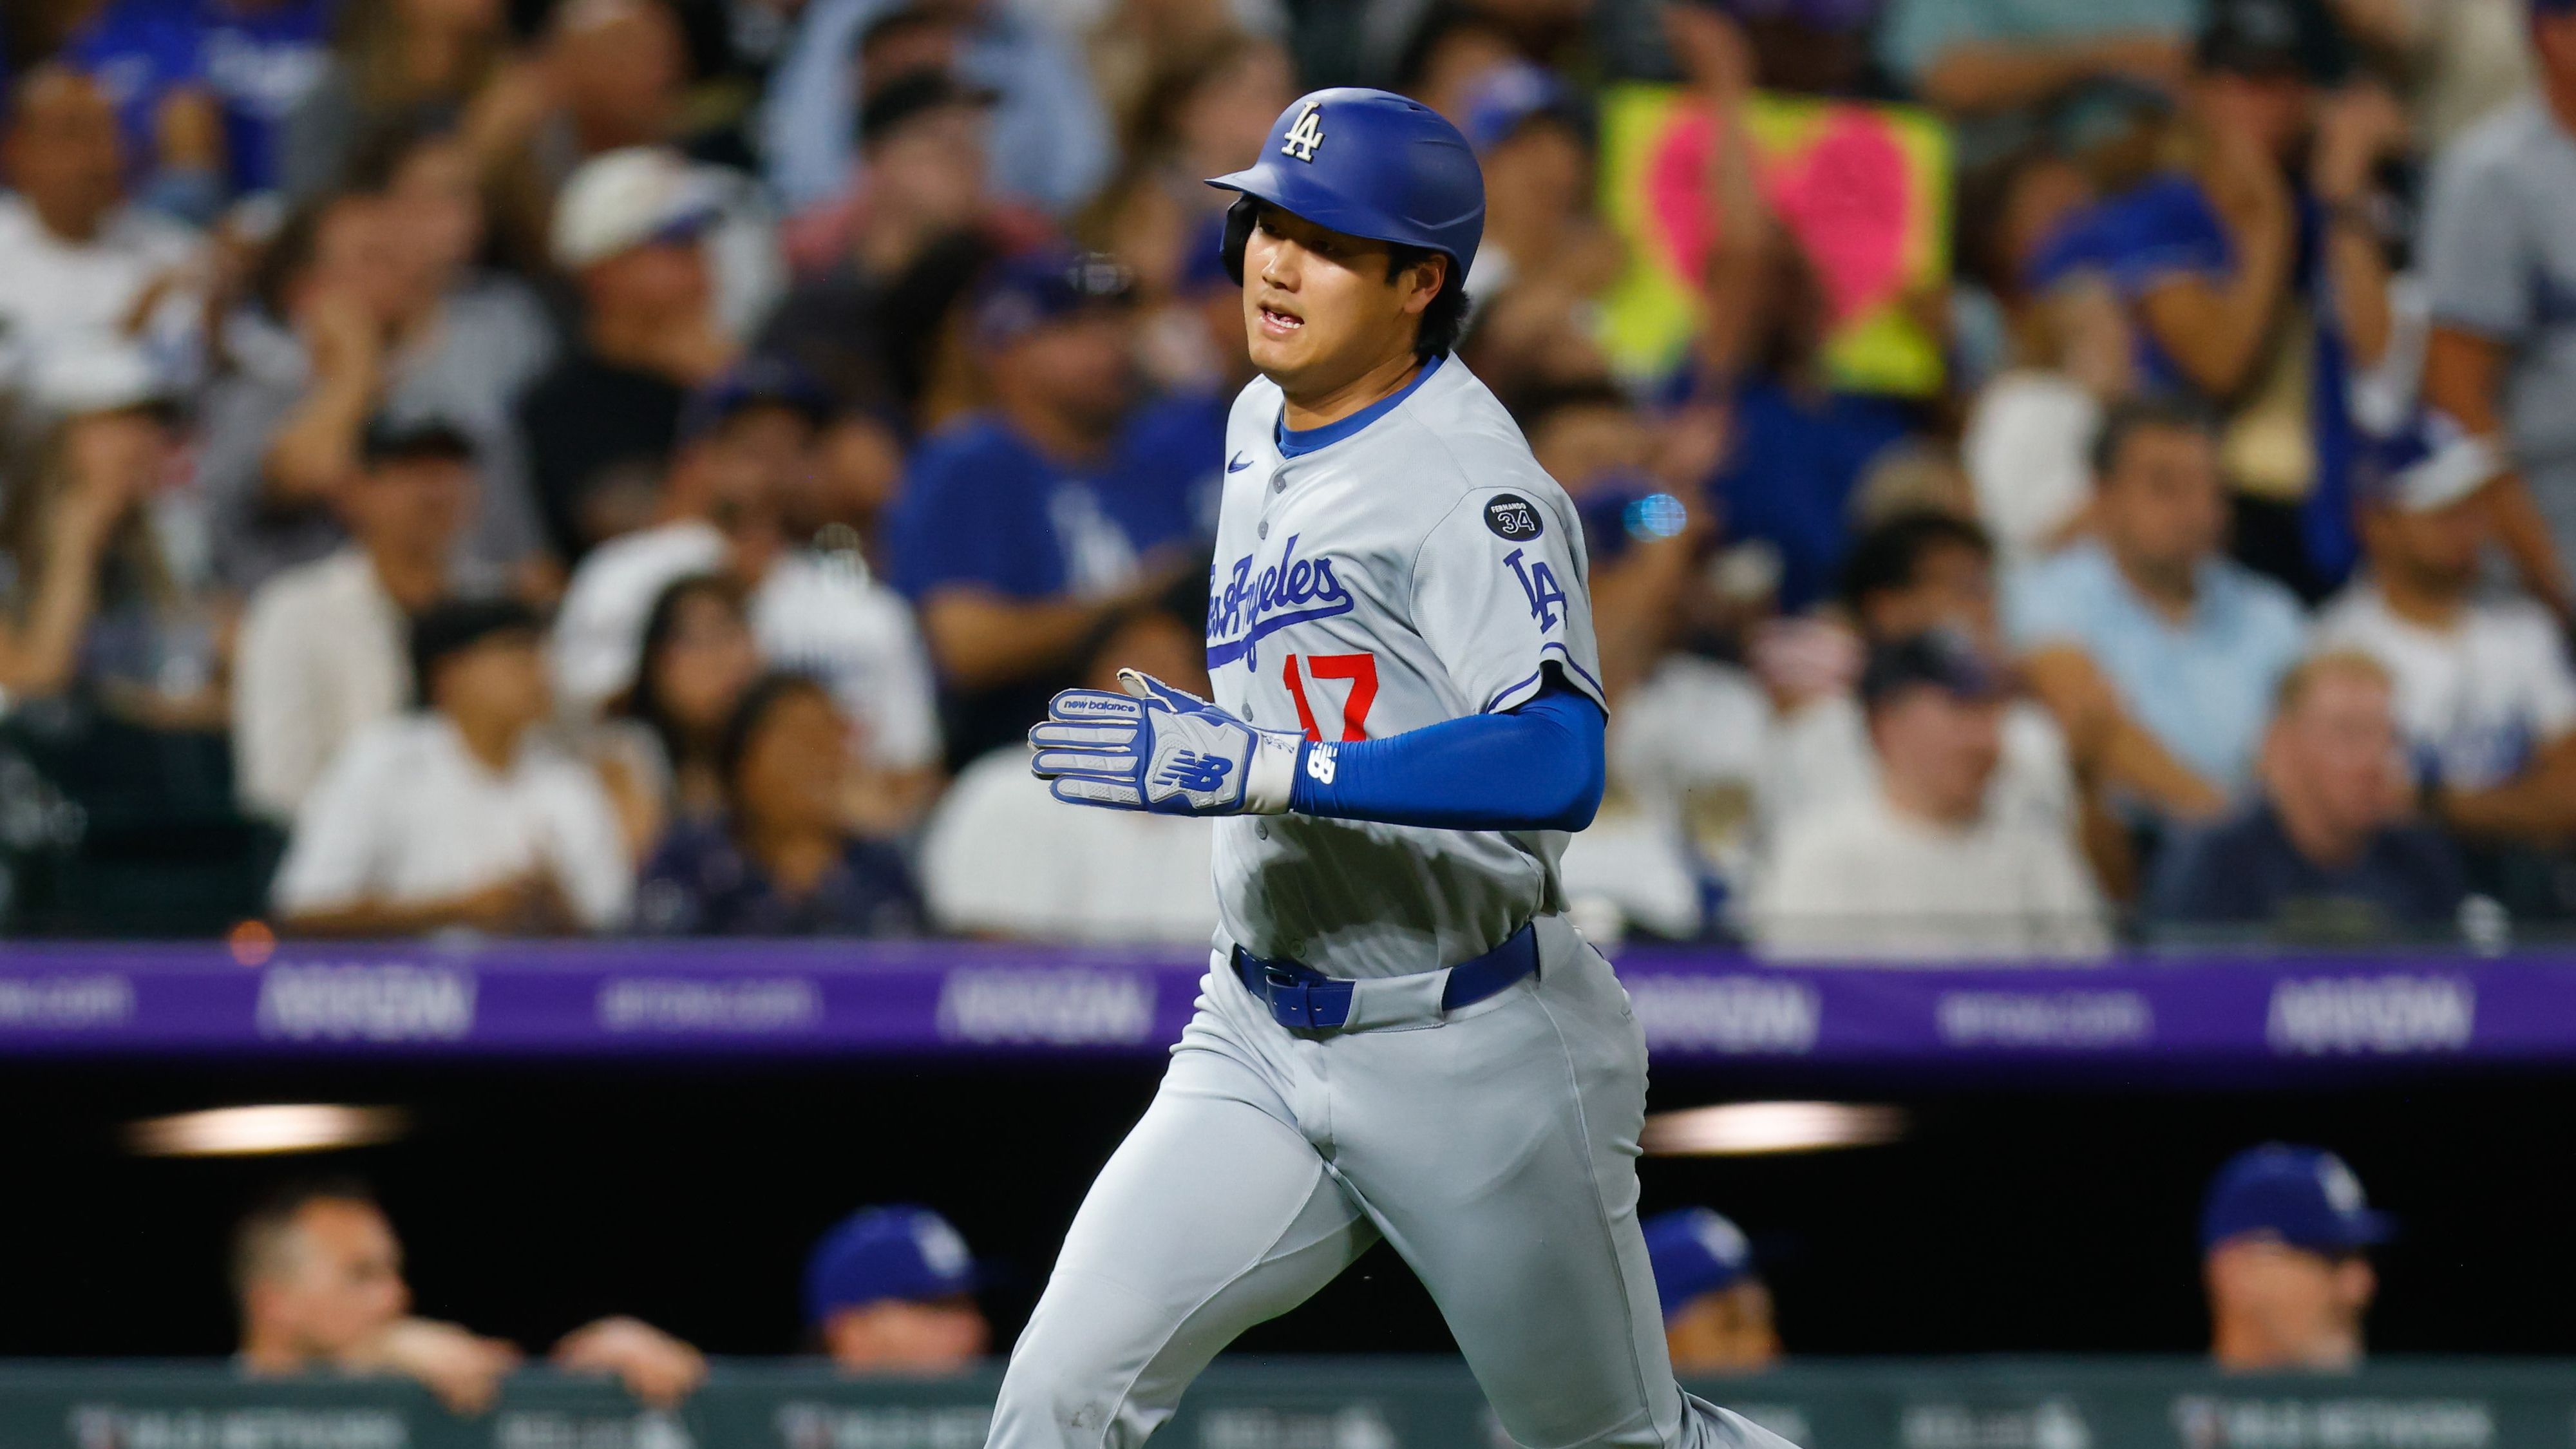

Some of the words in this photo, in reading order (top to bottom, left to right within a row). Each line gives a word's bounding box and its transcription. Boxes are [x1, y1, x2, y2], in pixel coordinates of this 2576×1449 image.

[1282, 101, 1323, 162] LA
[1491, 502, 1526, 513] FERNANDO
[1497, 510, 1535, 534] 34
[1220, 533, 1354, 672] Angeles
[1503, 548, 1567, 634] LA
[1088, 701, 1135, 712] balance
[1283, 654, 1378, 743] 17
